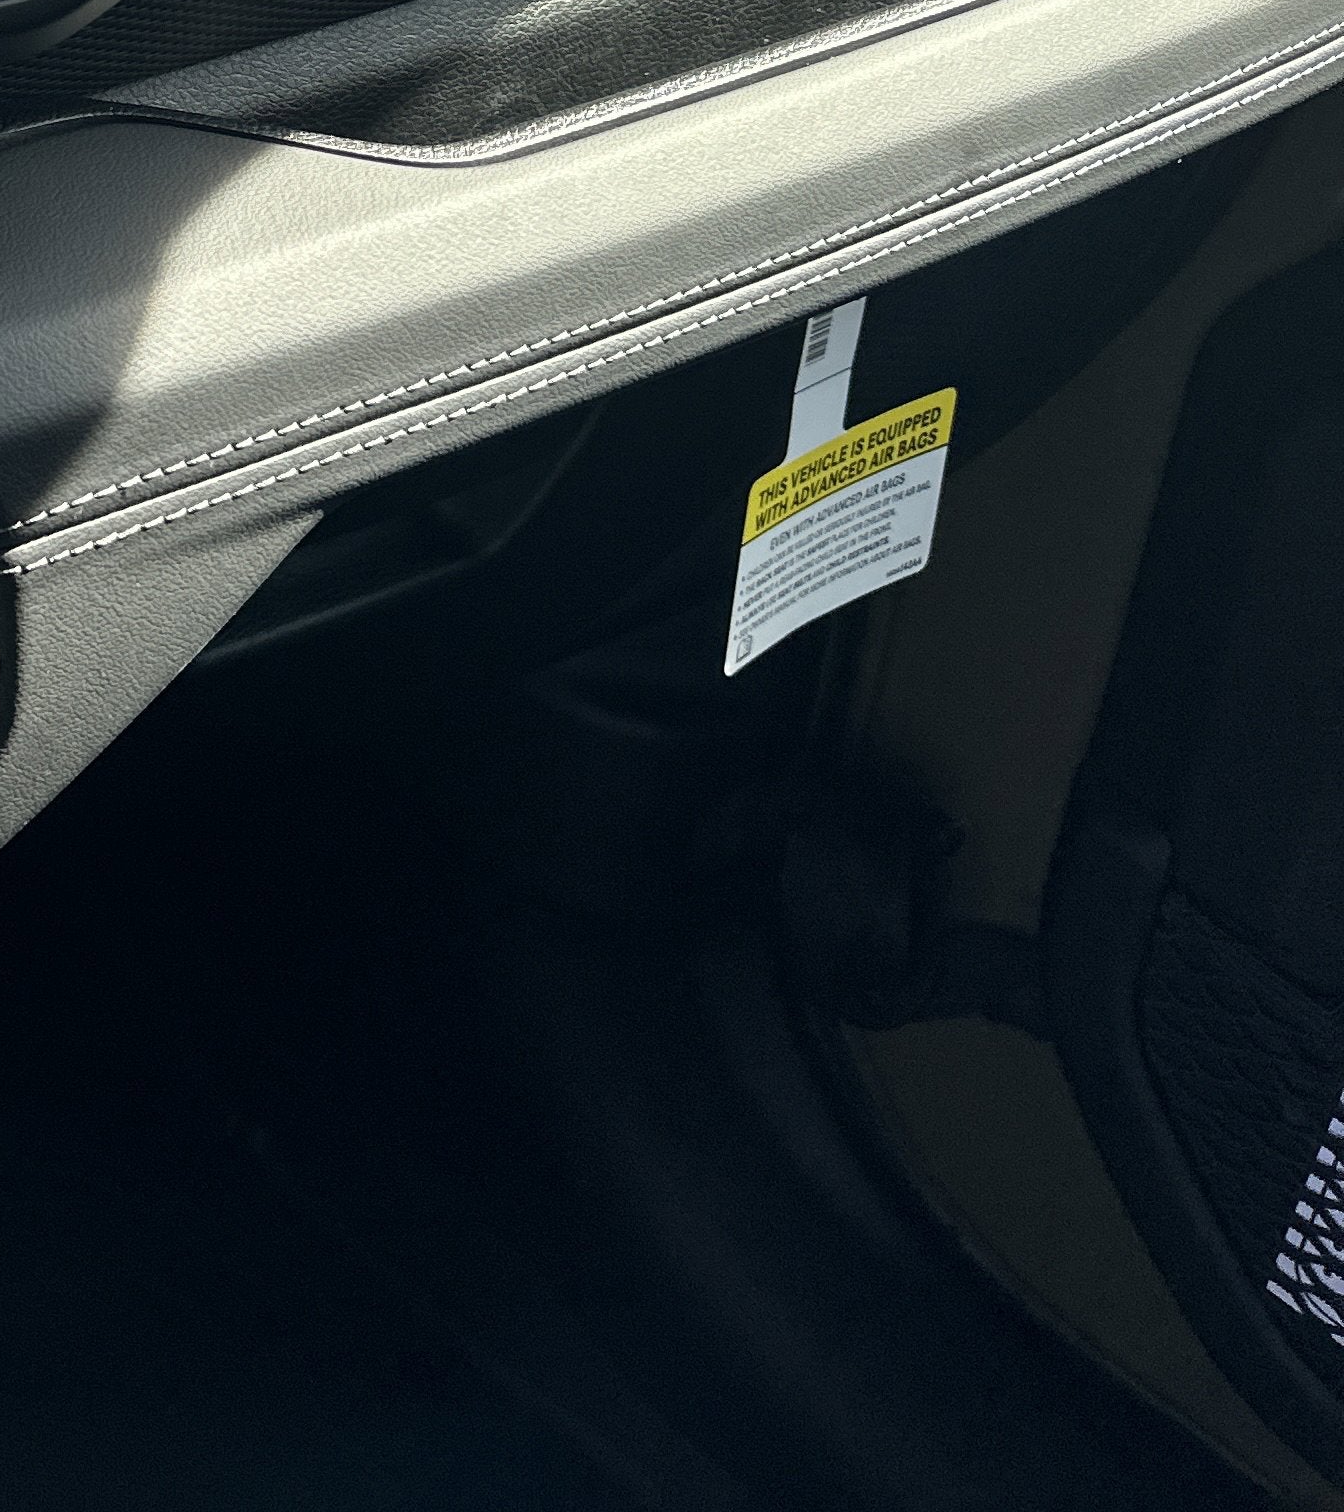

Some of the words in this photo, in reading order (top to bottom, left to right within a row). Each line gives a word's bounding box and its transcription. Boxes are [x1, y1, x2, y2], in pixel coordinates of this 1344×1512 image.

[756, 498, 789, 531] WITH
[790, 458, 866, 510] ADVANCED
[869, 448, 894, 470] AIR
[897, 428, 938, 458] BAGS
[759, 476, 787, 508] THIS
[791, 445, 848, 488] VEHICLE
[850, 437, 865, 458] IS
[867, 407, 941, 451] EQUIPPED
